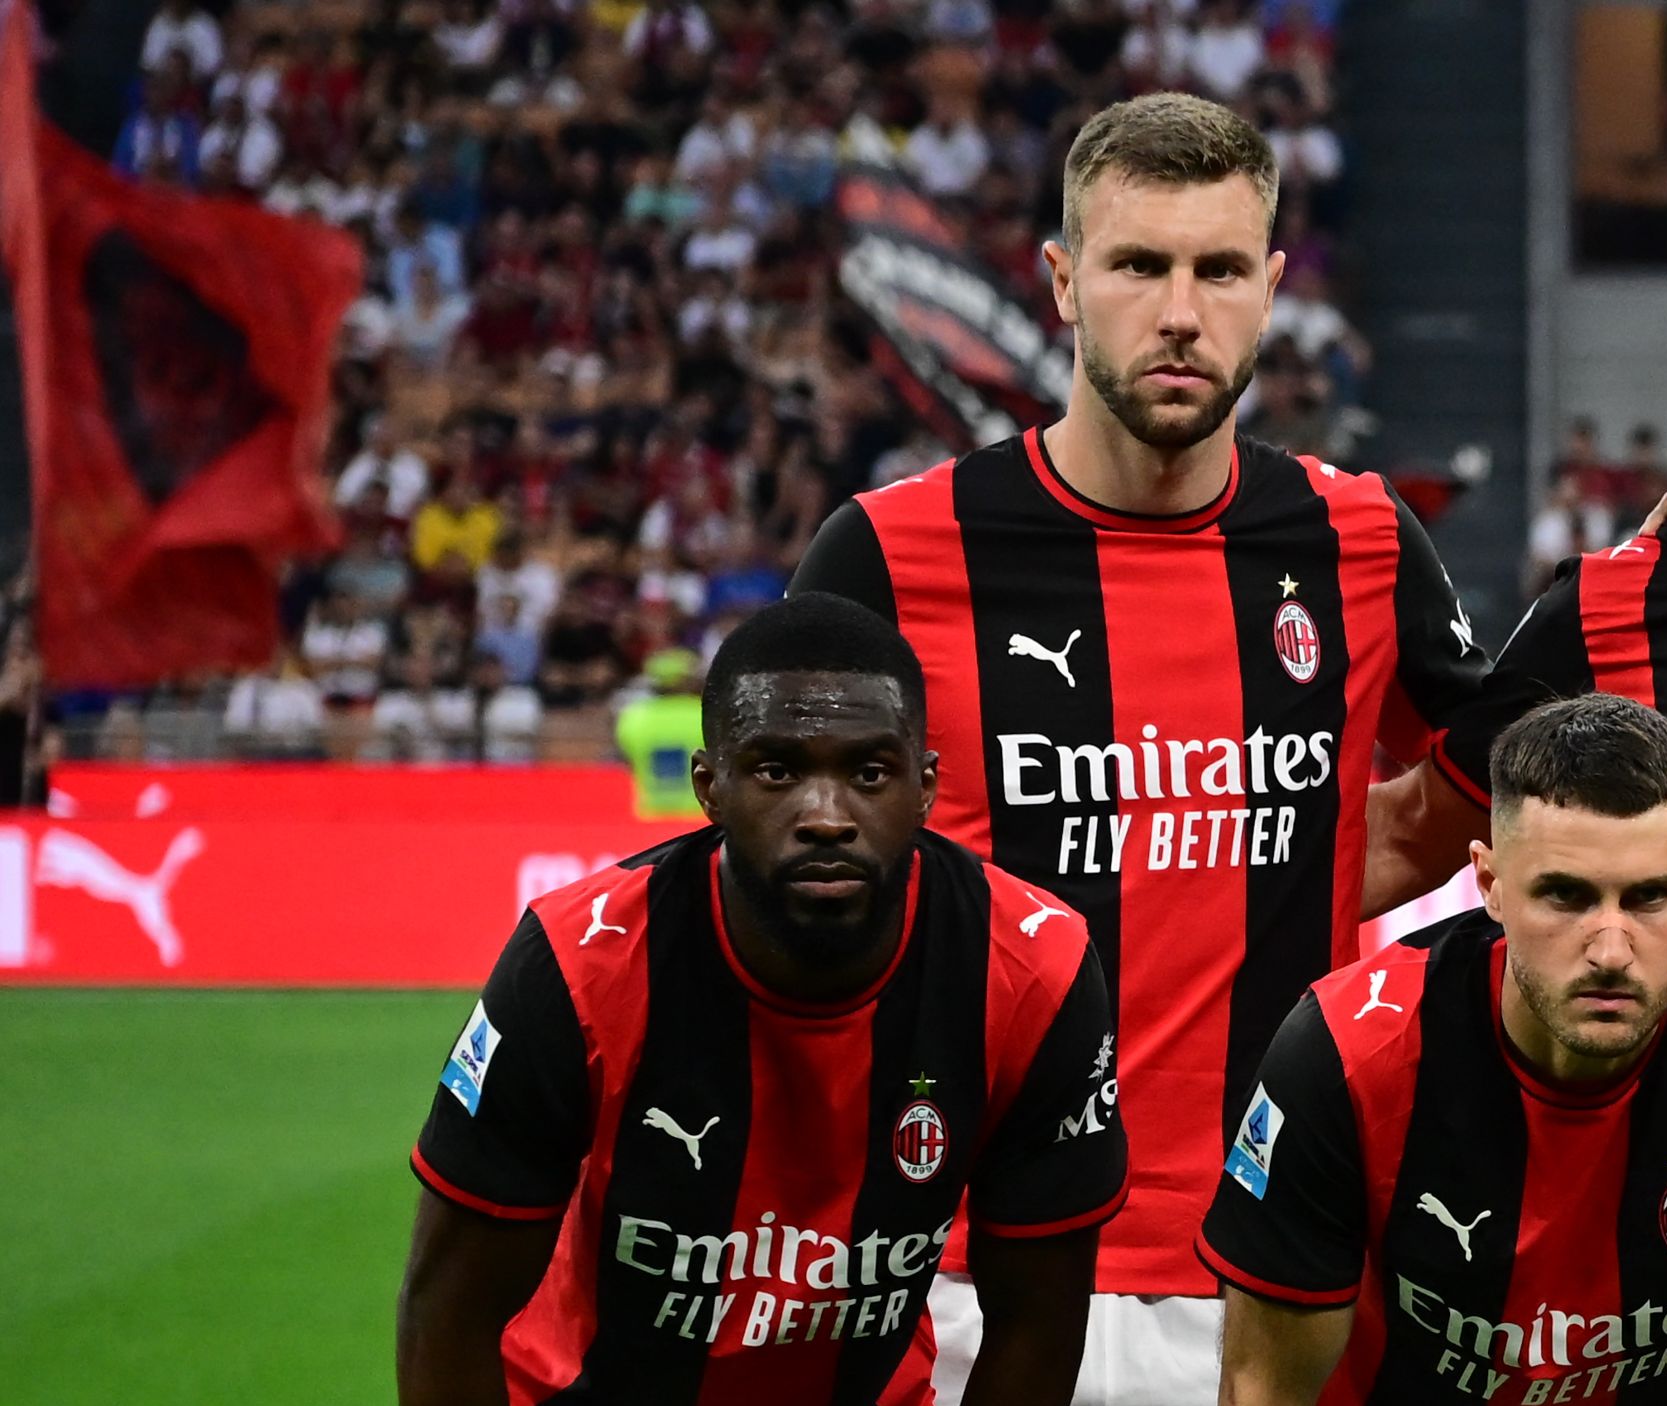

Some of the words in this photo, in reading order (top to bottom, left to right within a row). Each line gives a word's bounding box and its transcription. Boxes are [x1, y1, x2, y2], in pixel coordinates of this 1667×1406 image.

[1281, 606, 1308, 623] ACM
[996, 724, 1333, 806] Emirates
[1058, 812, 1131, 875] FLY
[1147, 806, 1296, 871] BETTER
[906, 1108, 937, 1123] ACM
[906, 1164, 933, 1175] 1899
[615, 1211, 954, 1290] Emirates
[653, 1291, 737, 1343] FLY
[742, 1288, 909, 1347] BETTER
[1437, 1348, 1511, 1402] FLY
